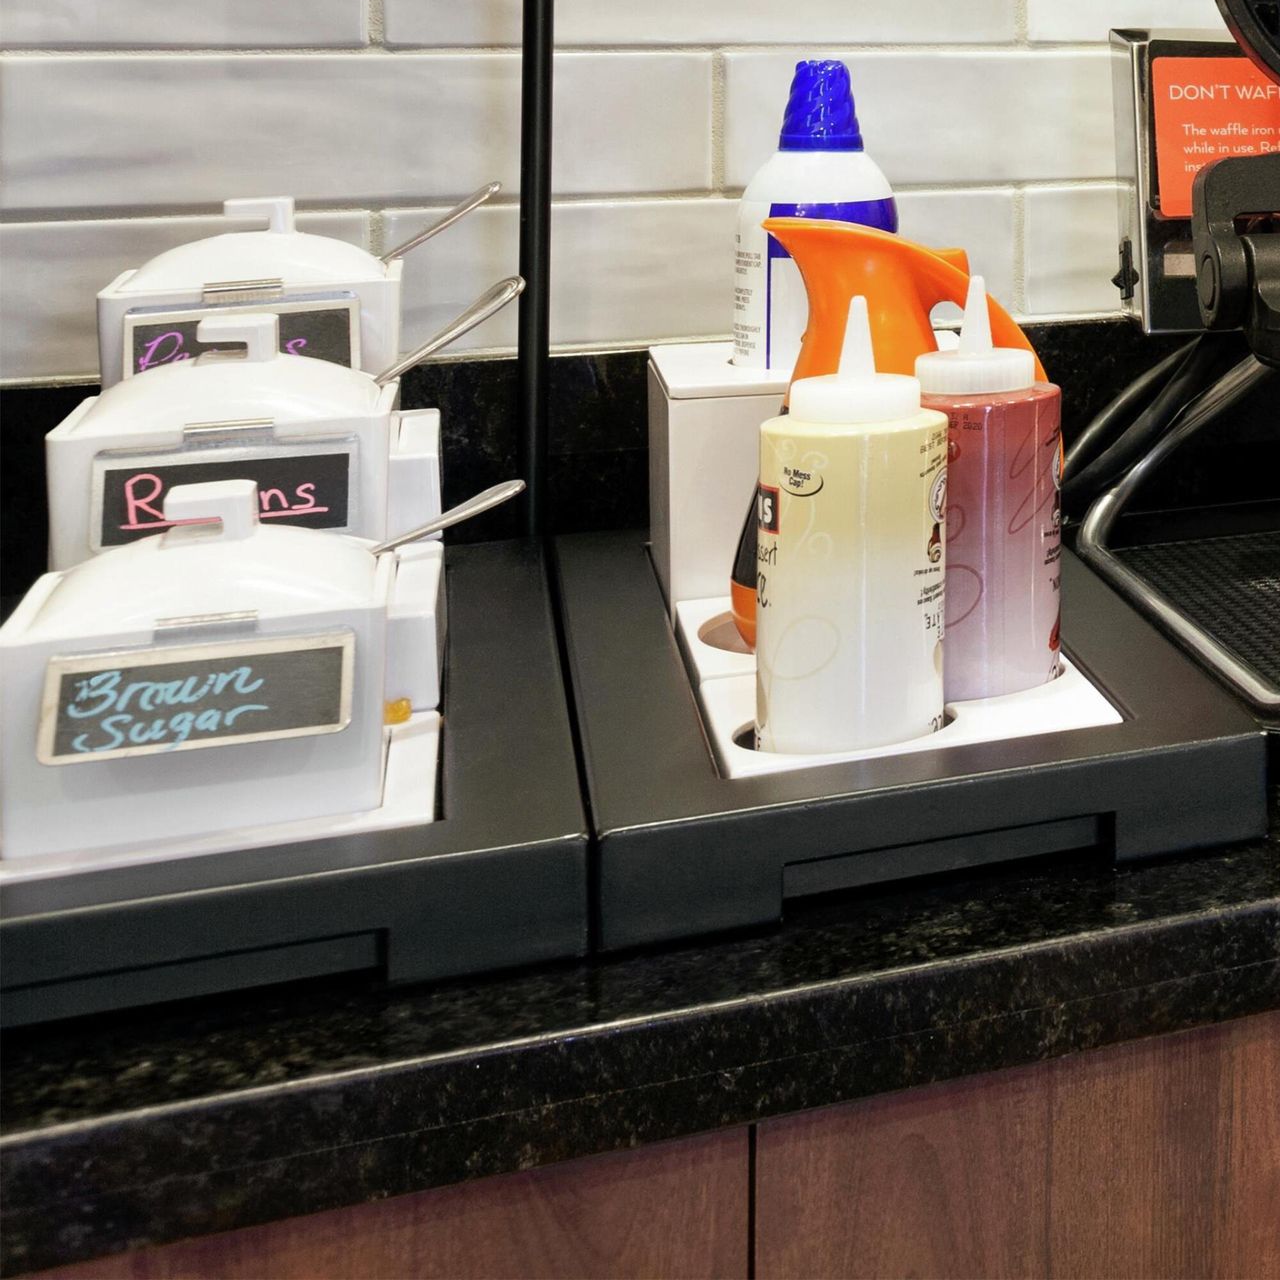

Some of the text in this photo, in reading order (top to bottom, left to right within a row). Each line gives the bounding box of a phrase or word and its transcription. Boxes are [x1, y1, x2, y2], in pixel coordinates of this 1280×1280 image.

[1169, 84, 1231, 100] DON'T
[1182, 123, 1207, 136] The
[1210, 122, 1248, 136] waffle
[1251, 124, 1275, 136] iron
[1183, 141, 1216, 154] while
[1218, 141, 1230, 153] in
[1233, 144, 1257, 153] use.
[792, 469, 811, 481] Mess
[67, 666, 264, 718] Brown
[72, 704, 269, 753] Sugar
